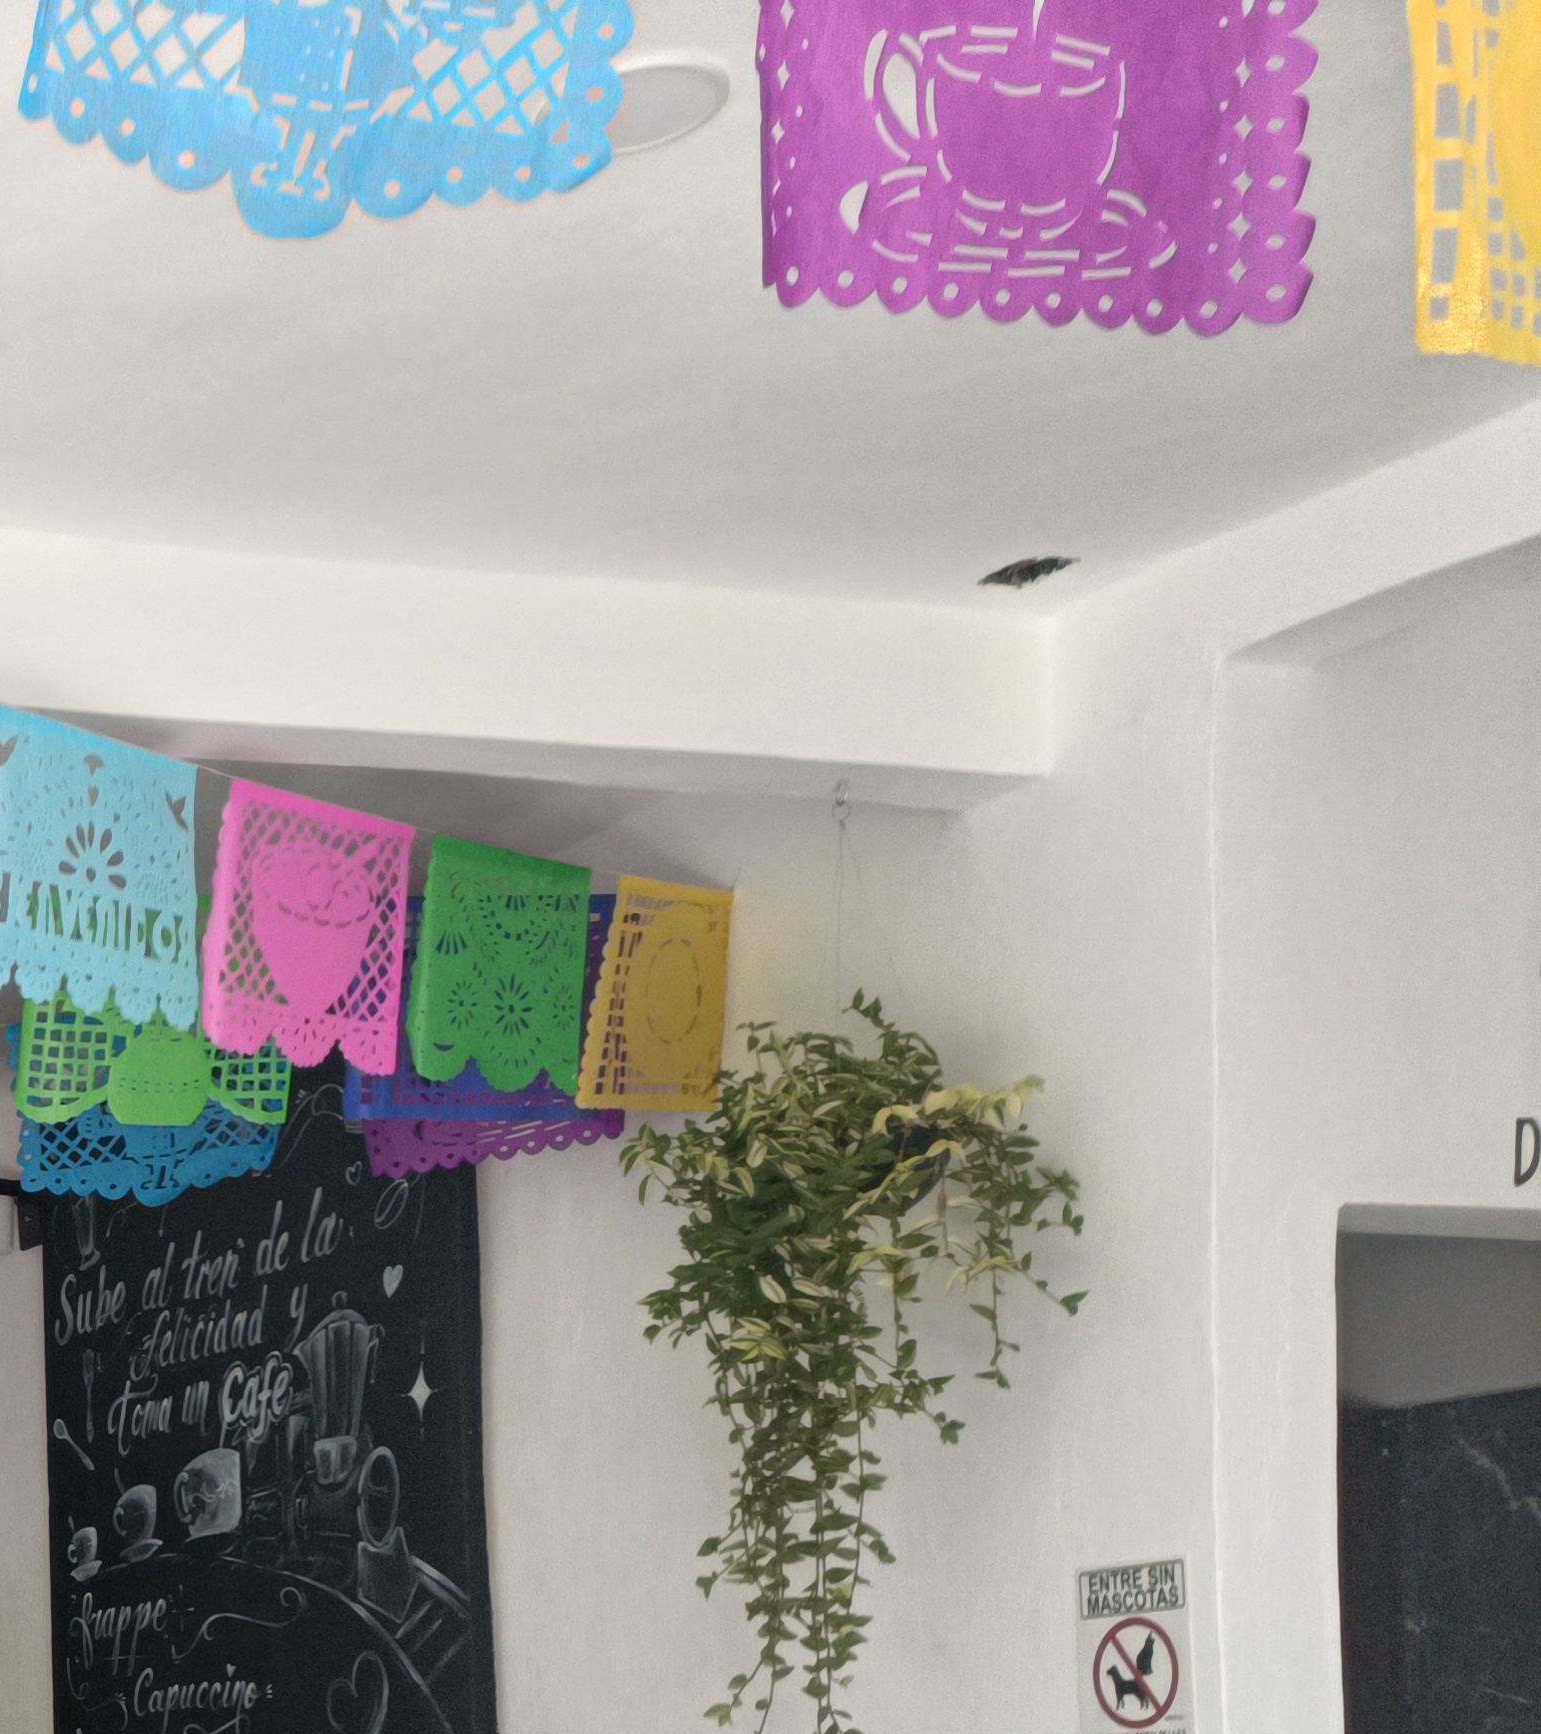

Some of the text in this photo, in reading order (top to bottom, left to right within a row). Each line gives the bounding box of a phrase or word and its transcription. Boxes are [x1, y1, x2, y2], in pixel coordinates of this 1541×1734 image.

[54, 1187, 344, 1346] Sube al tren de la
[286, 1283, 309, 1350] y
[1087, 1584, 1180, 1618] MASCOTAS
[1088, 1563, 1175, 1595] ENTRE SIN
